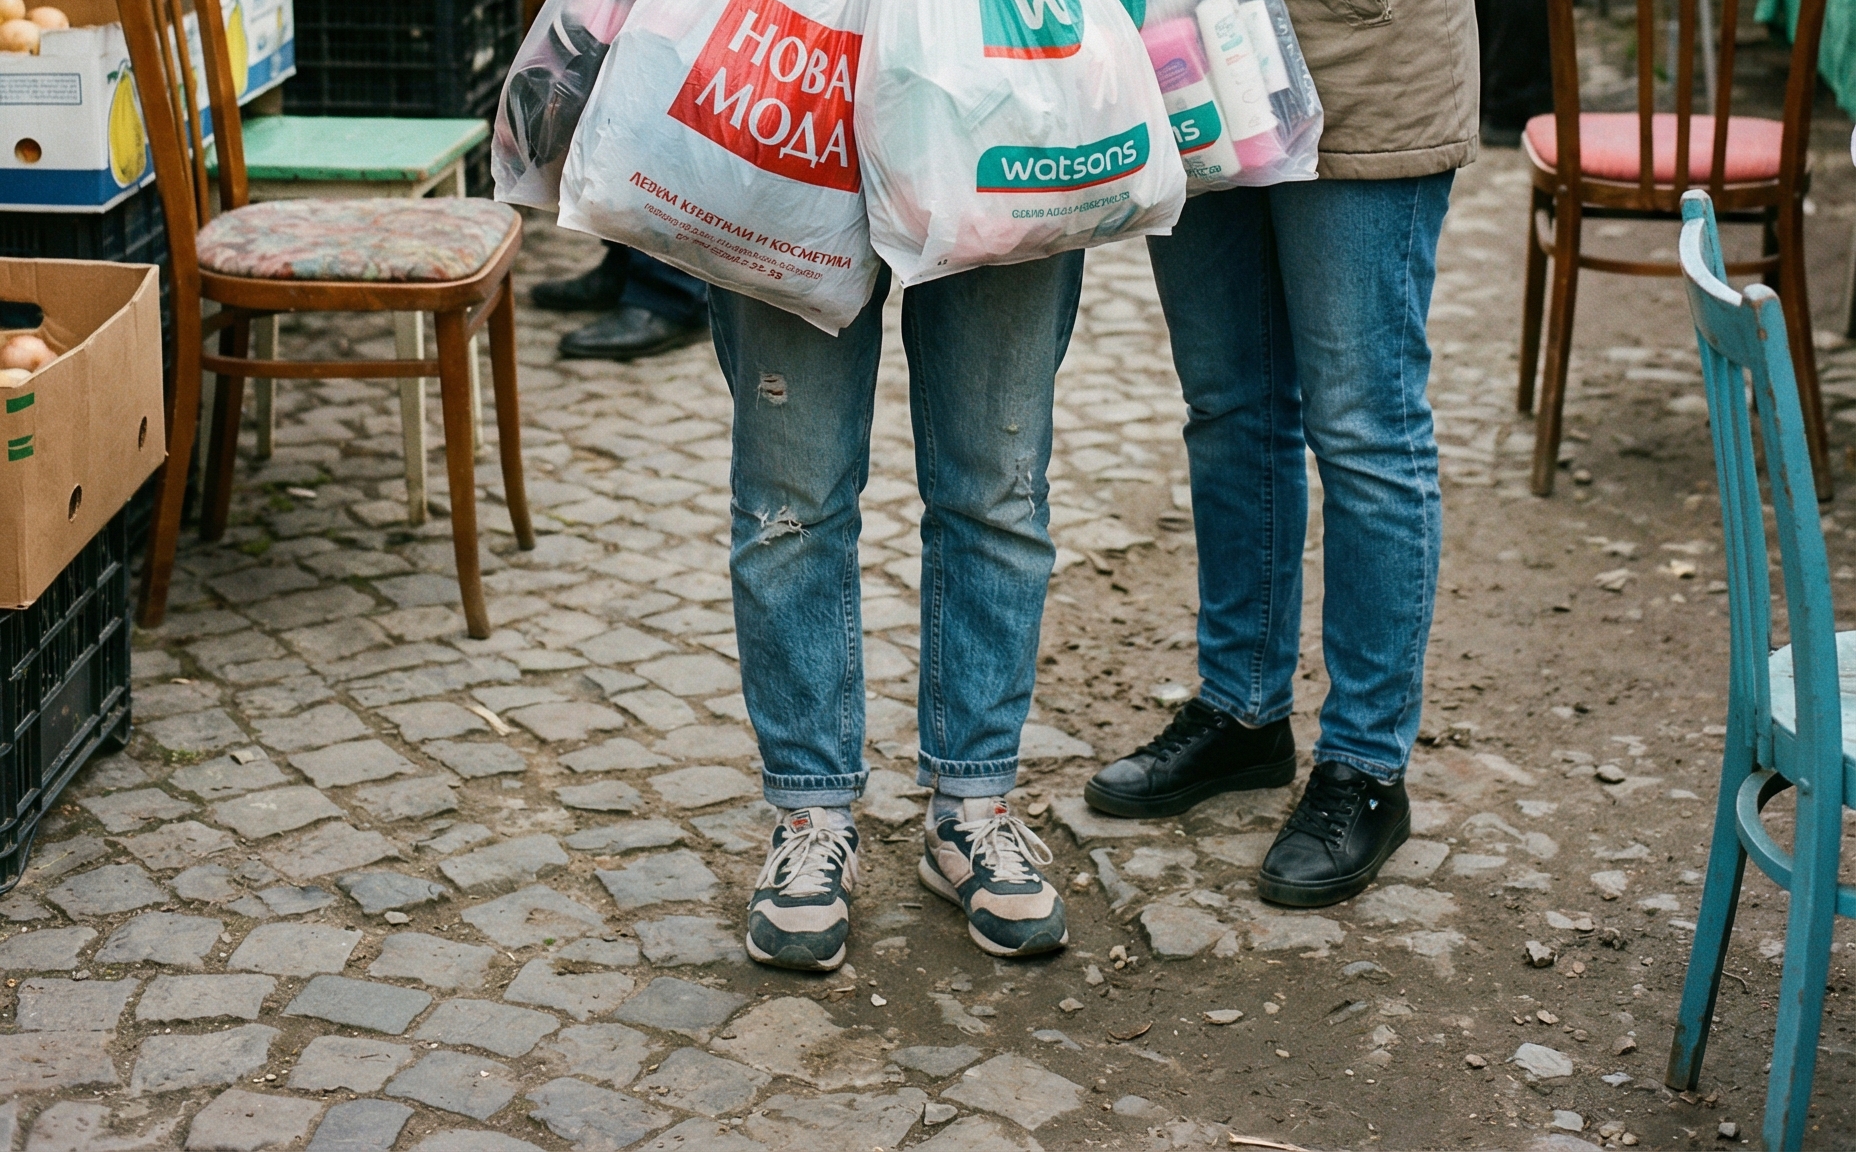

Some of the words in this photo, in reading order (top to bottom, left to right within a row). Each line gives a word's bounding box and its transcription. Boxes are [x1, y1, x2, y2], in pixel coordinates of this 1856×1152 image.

[728, 9, 853, 102] НОВА
[695, 67, 849, 168] МОДА
[1001, 139, 1137, 181] watsons
